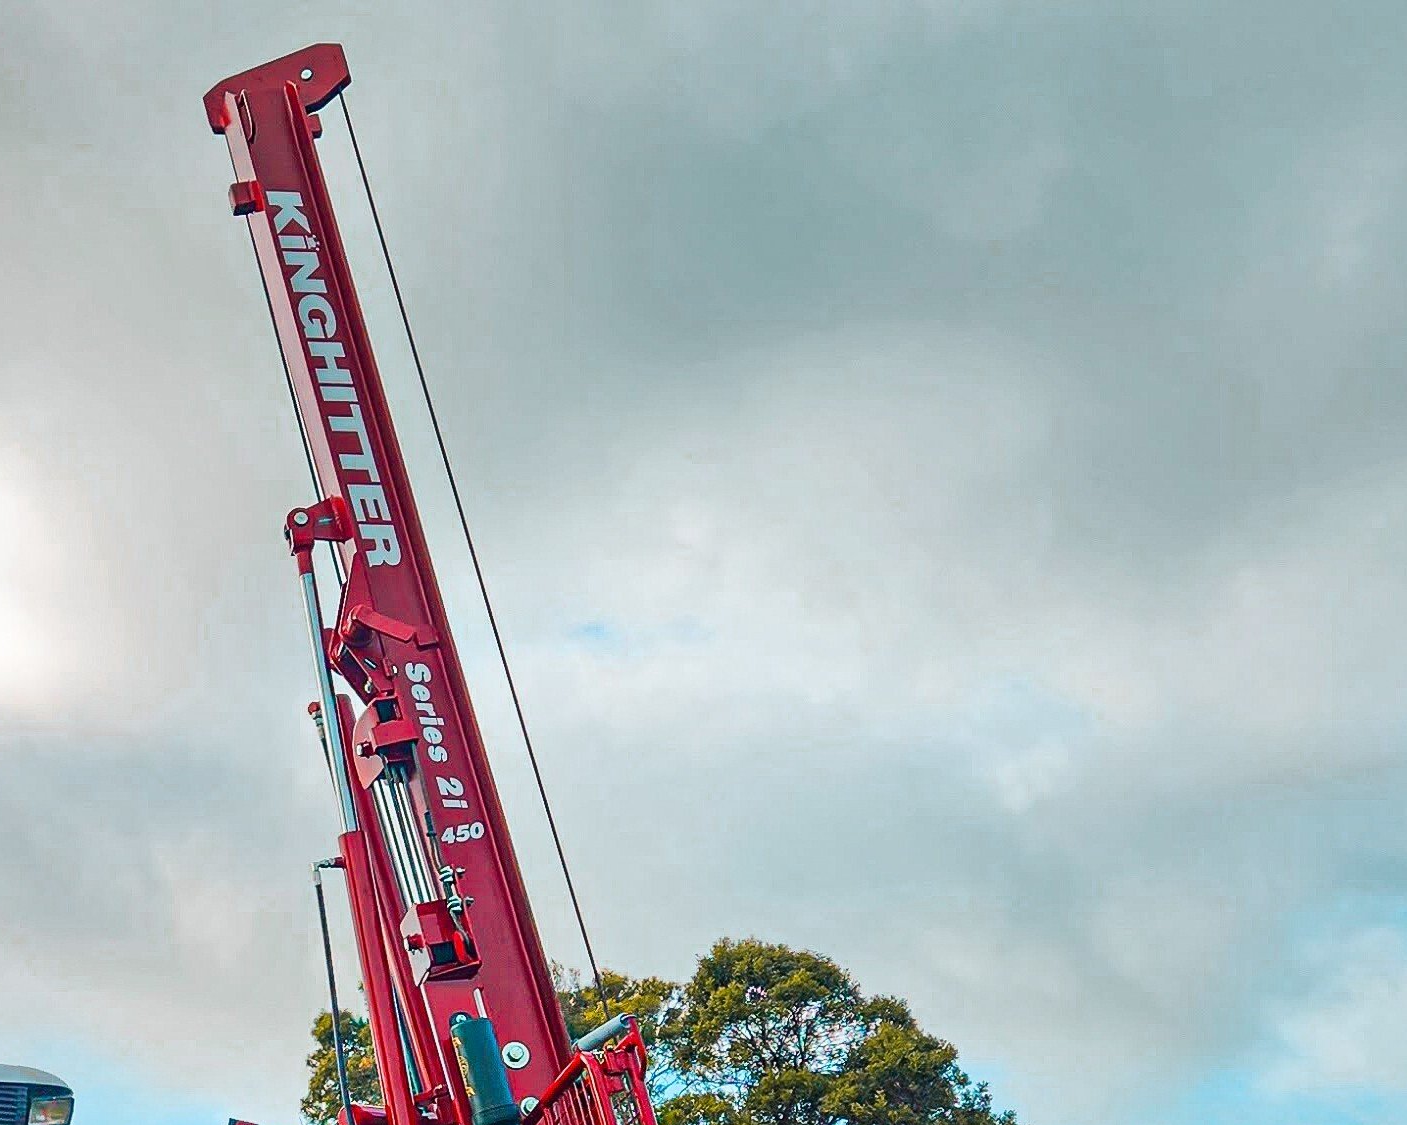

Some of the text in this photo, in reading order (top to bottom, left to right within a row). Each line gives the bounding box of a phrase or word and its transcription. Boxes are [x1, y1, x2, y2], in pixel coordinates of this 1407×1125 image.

[265, 190, 402, 567] KINGHITTER
[405, 662, 468, 808] Series 2i
[441, 822, 485, 844] 450
